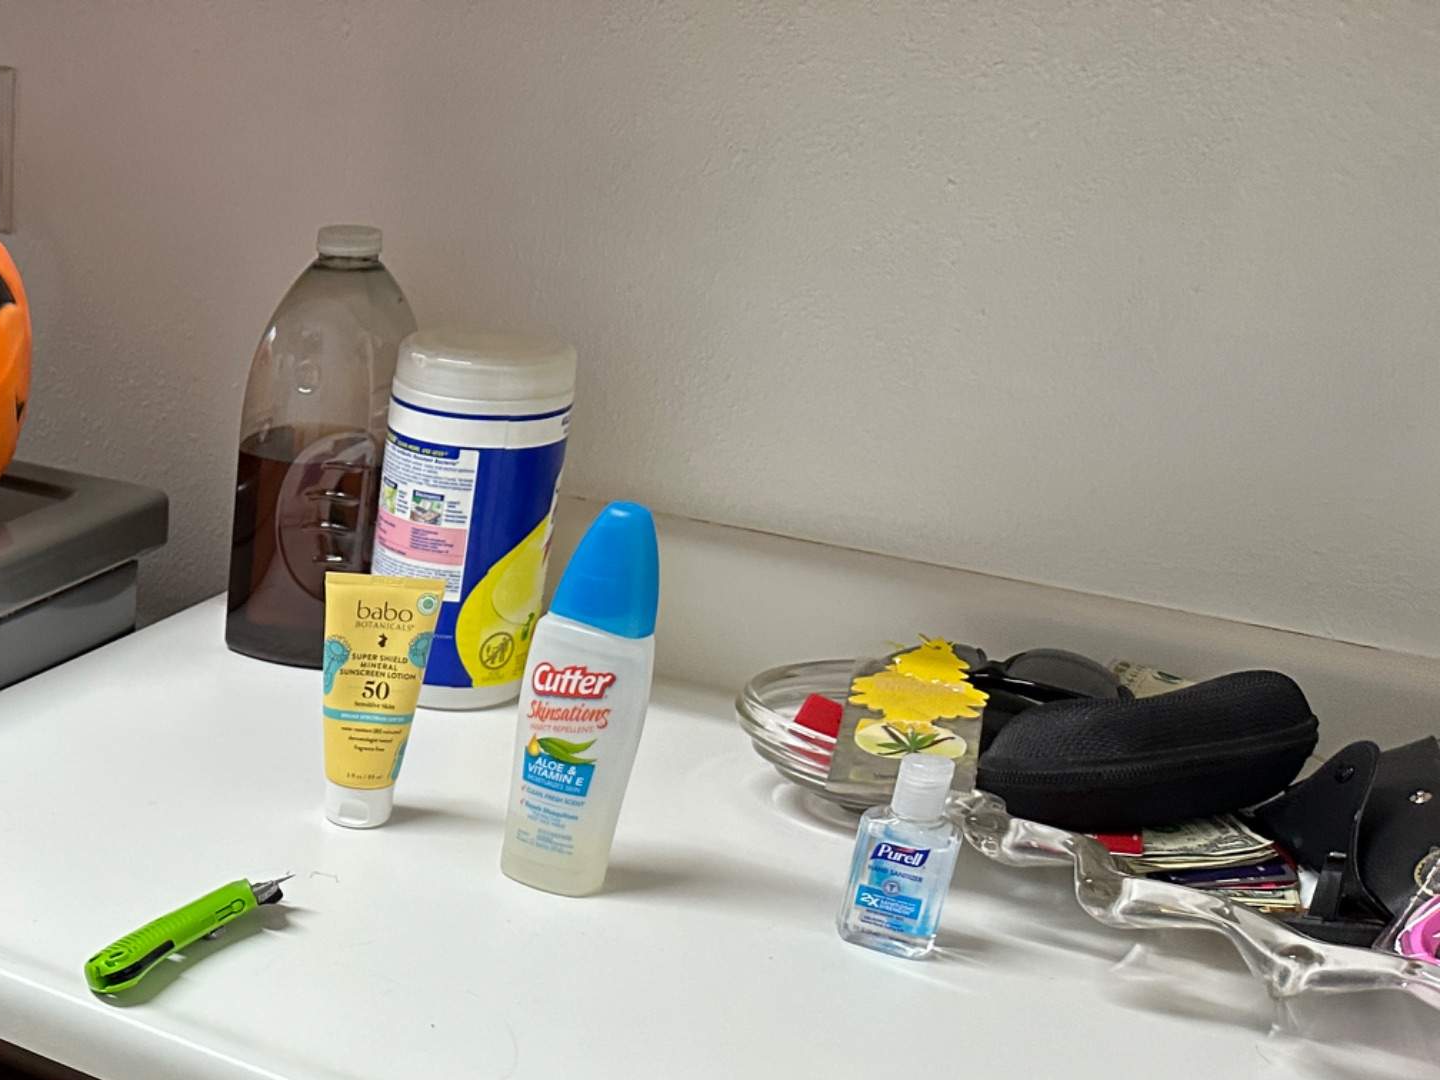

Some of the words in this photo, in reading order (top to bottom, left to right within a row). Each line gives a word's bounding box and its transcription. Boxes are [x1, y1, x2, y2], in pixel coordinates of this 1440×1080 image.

[357, 600, 413, 622] babo
[360, 662, 397, 671] MINERAL
[380, 655, 409, 664] SHIELD
[340, 669, 385, 678] SUNSCREEN
[387, 672, 416, 680] LOTION
[534, 664, 612, 695] Cutter
[362, 681, 390, 700] 50
[527, 699, 610, 729] Skinsations
[528, 762, 573, 785] VITAMIN
[575, 777, 584, 787] E
[535, 757, 565, 773] ALOE
[567, 766, 577, 776] &
[877, 844, 924, 866] Purell
